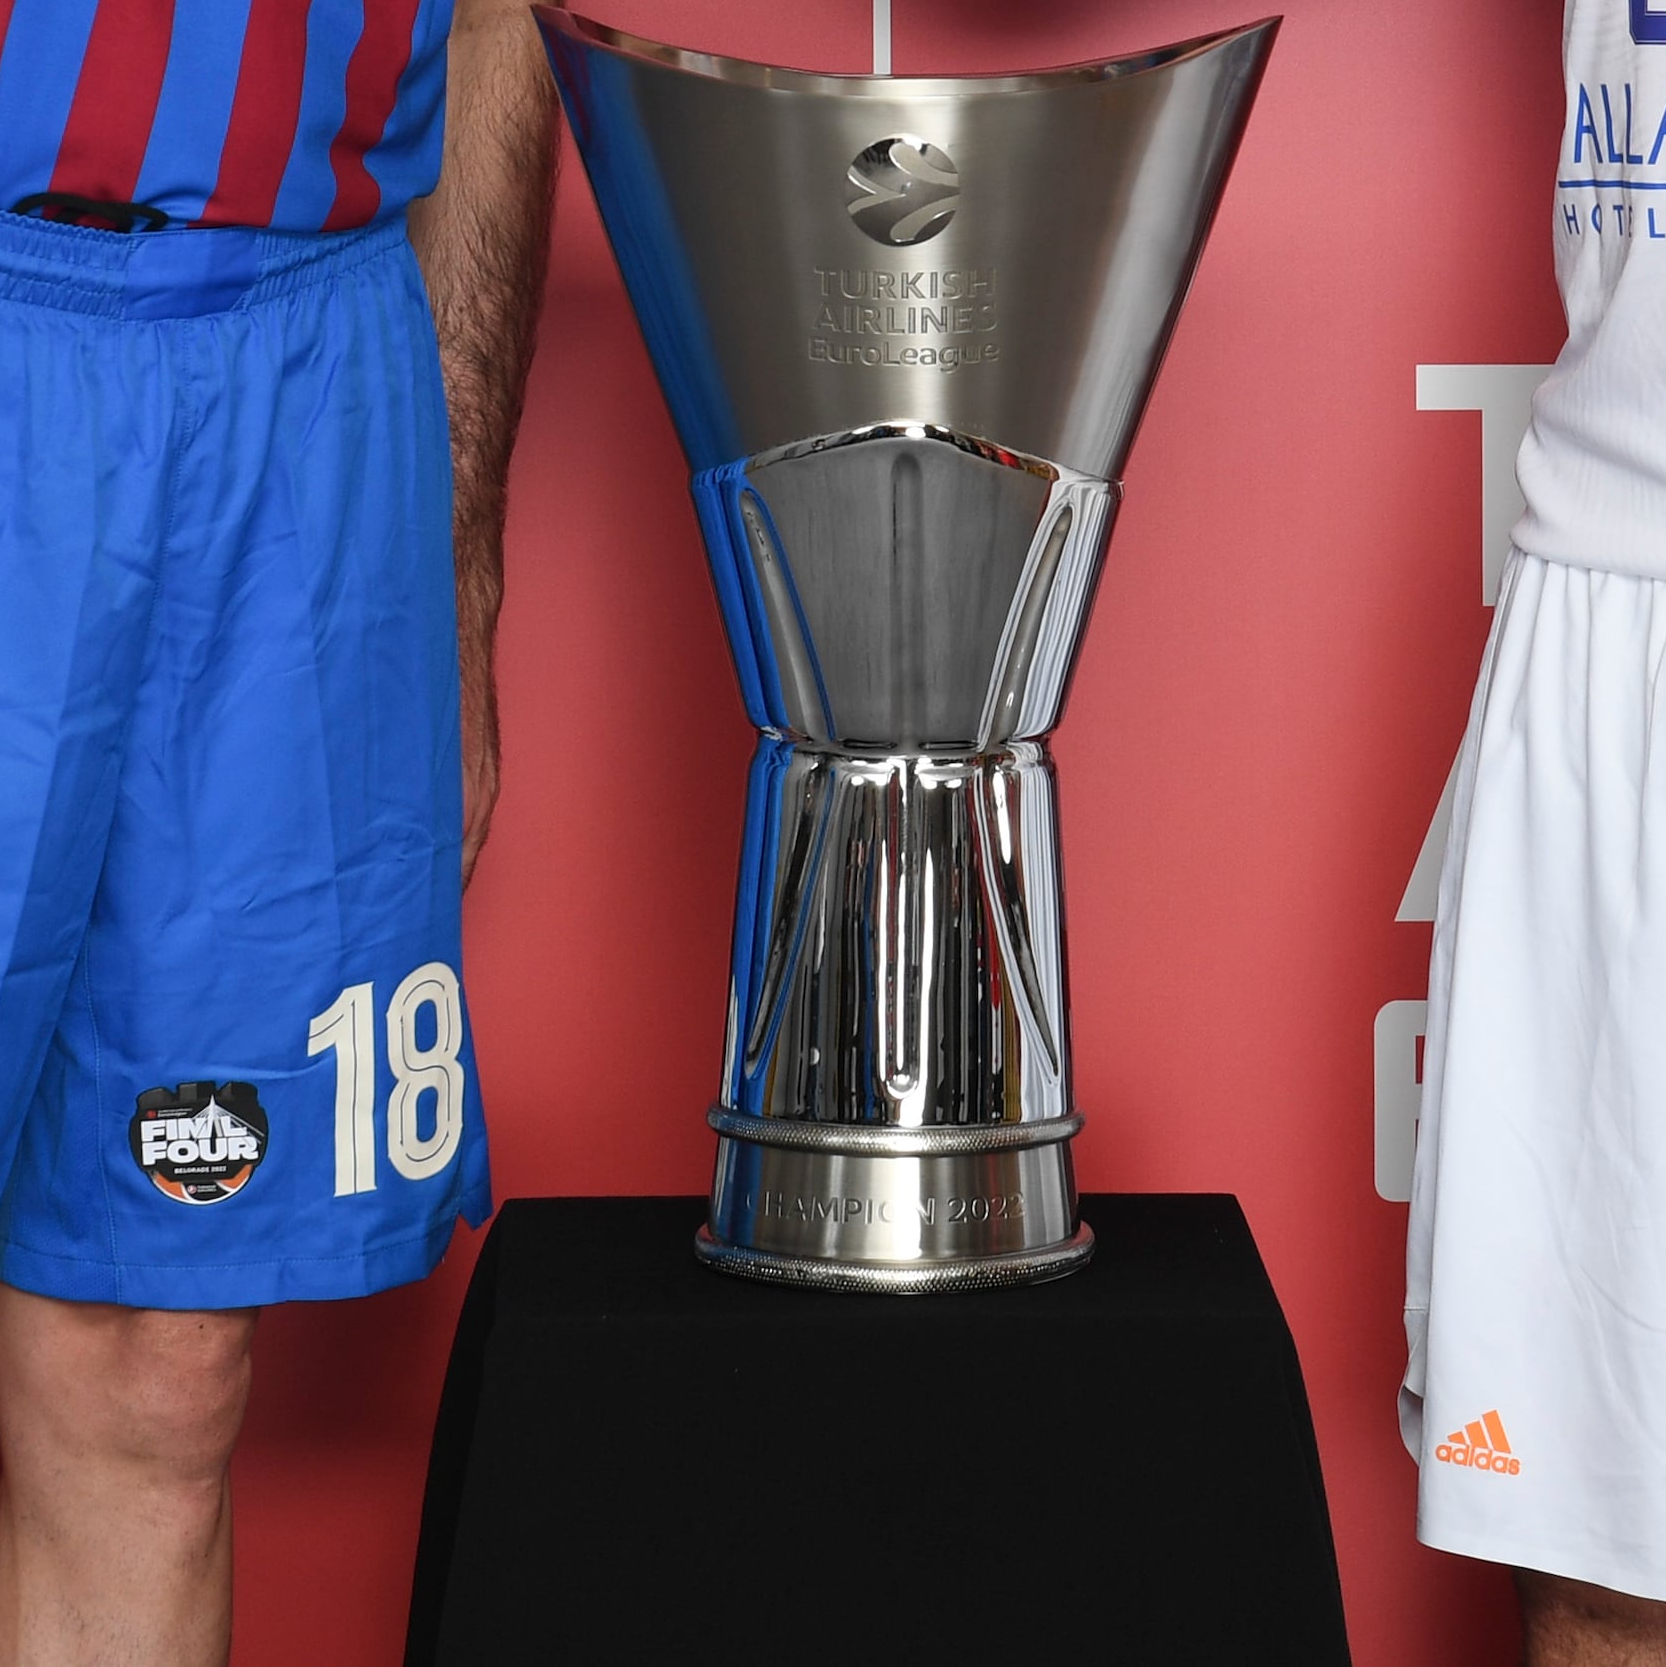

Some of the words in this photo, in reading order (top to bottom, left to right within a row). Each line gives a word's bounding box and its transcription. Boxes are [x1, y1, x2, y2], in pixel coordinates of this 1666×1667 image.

[1562, 202, 1666, 239] HOTL
[813, 266, 998, 301] TURKISH
[812, 303, 999, 336] AIRLINES
[808, 336, 1001, 375] EuroLeague
[307, 961, 464, 1198] 18
[141, 1136, 259, 1166] FOUR
[947, 1191, 1026, 1224] 2022
[1435, 1443, 1521, 1476] adidas
